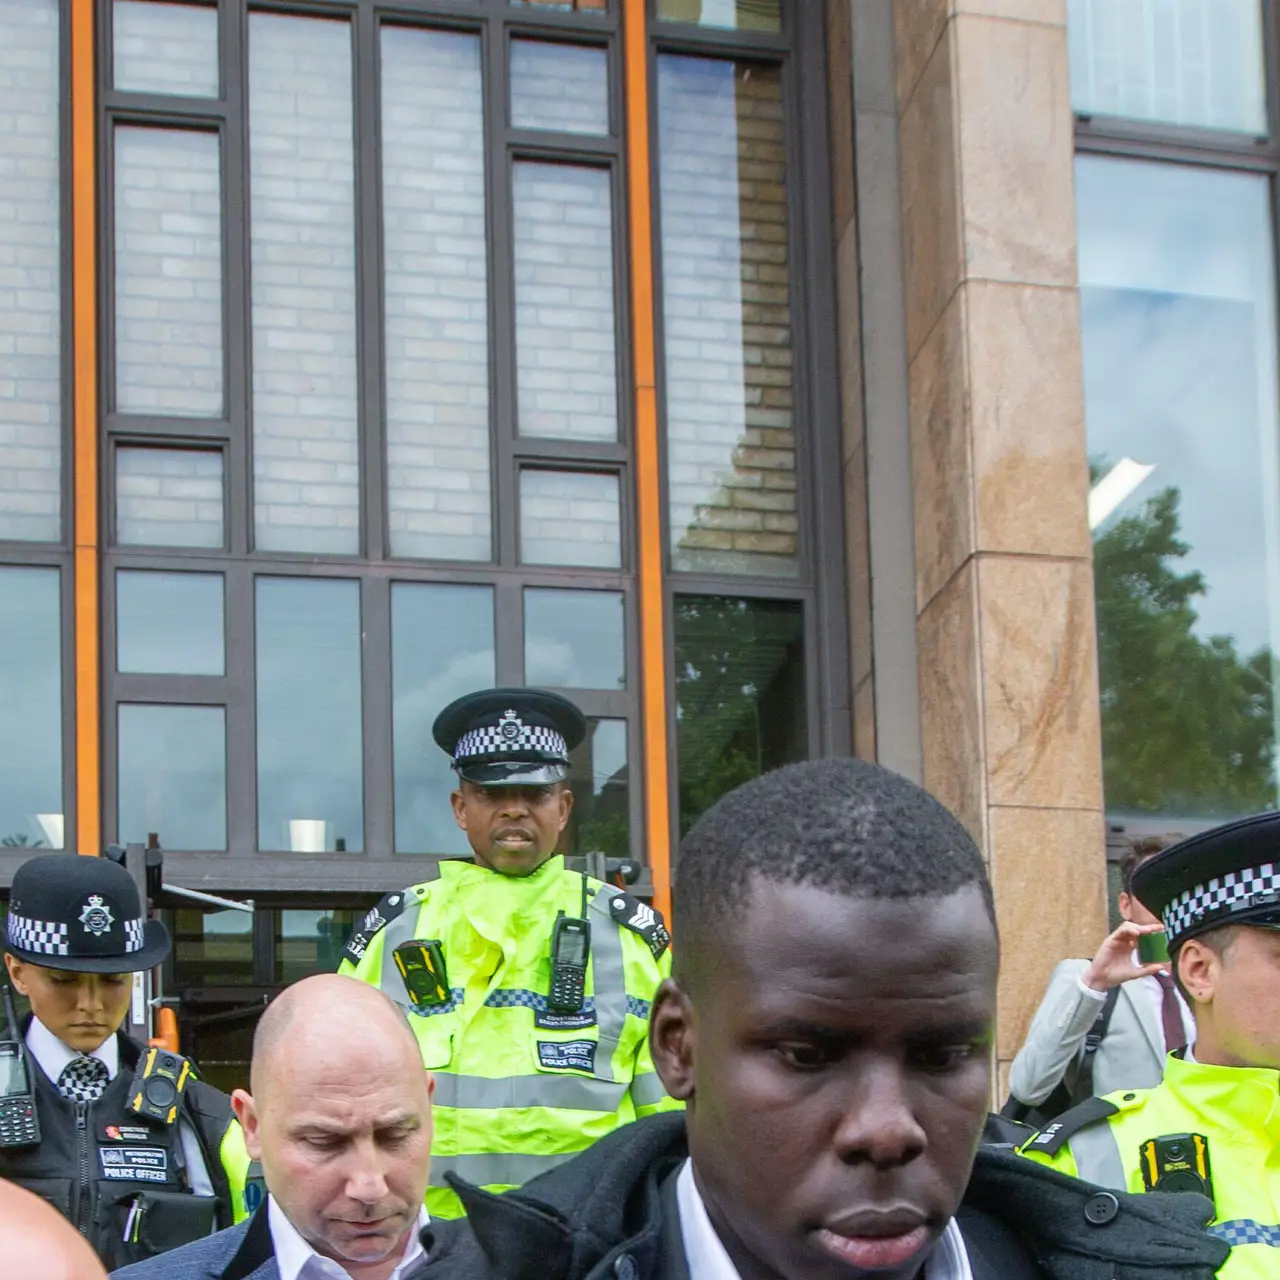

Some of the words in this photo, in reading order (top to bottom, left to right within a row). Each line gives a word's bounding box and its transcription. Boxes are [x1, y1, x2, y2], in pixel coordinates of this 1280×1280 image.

[541, 1058, 568, 1066] POLICE
[104, 1168, 135, 1178] POLICE
[135, 1169, 166, 1181] OFFICER
